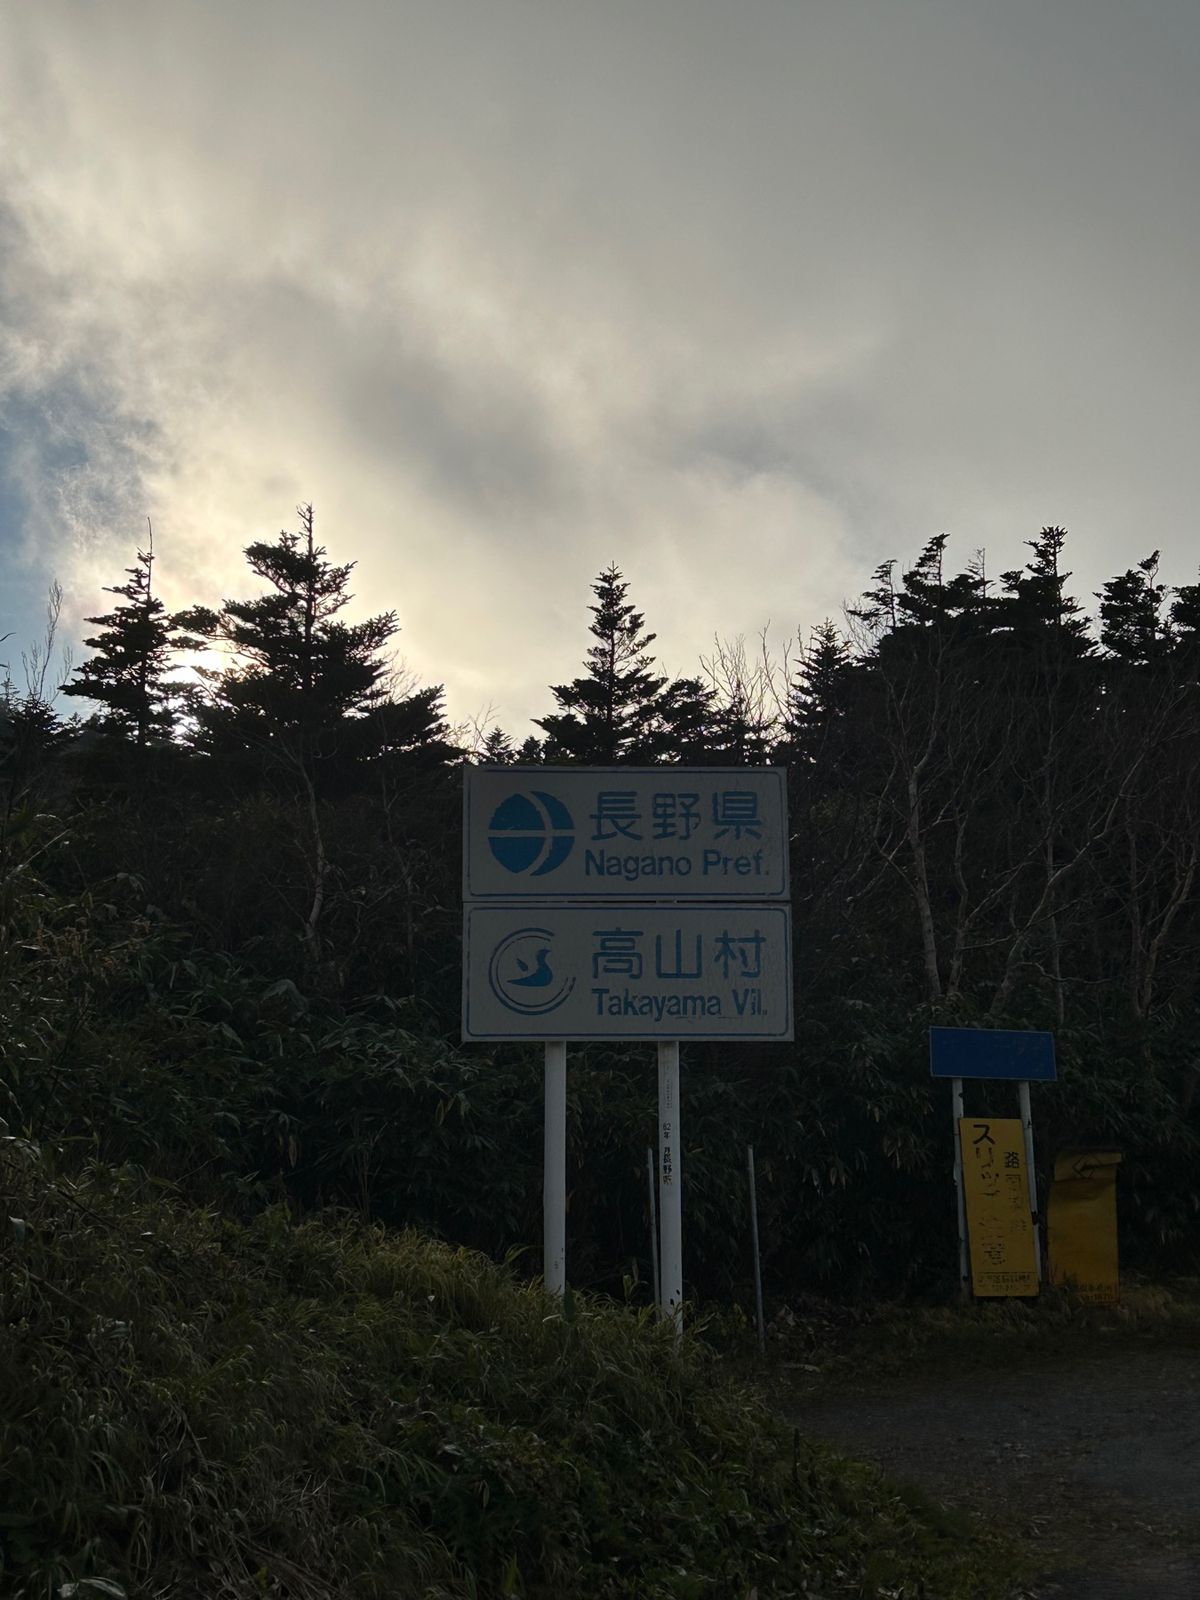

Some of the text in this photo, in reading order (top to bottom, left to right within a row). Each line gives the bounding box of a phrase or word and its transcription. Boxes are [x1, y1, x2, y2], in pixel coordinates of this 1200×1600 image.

[590, 791, 762, 840] 長野県
[585, 850, 769, 881] Nagano Pref.
[592, 927, 766, 979] 高山村
[591, 988, 768, 1022] Takayama Vil.
